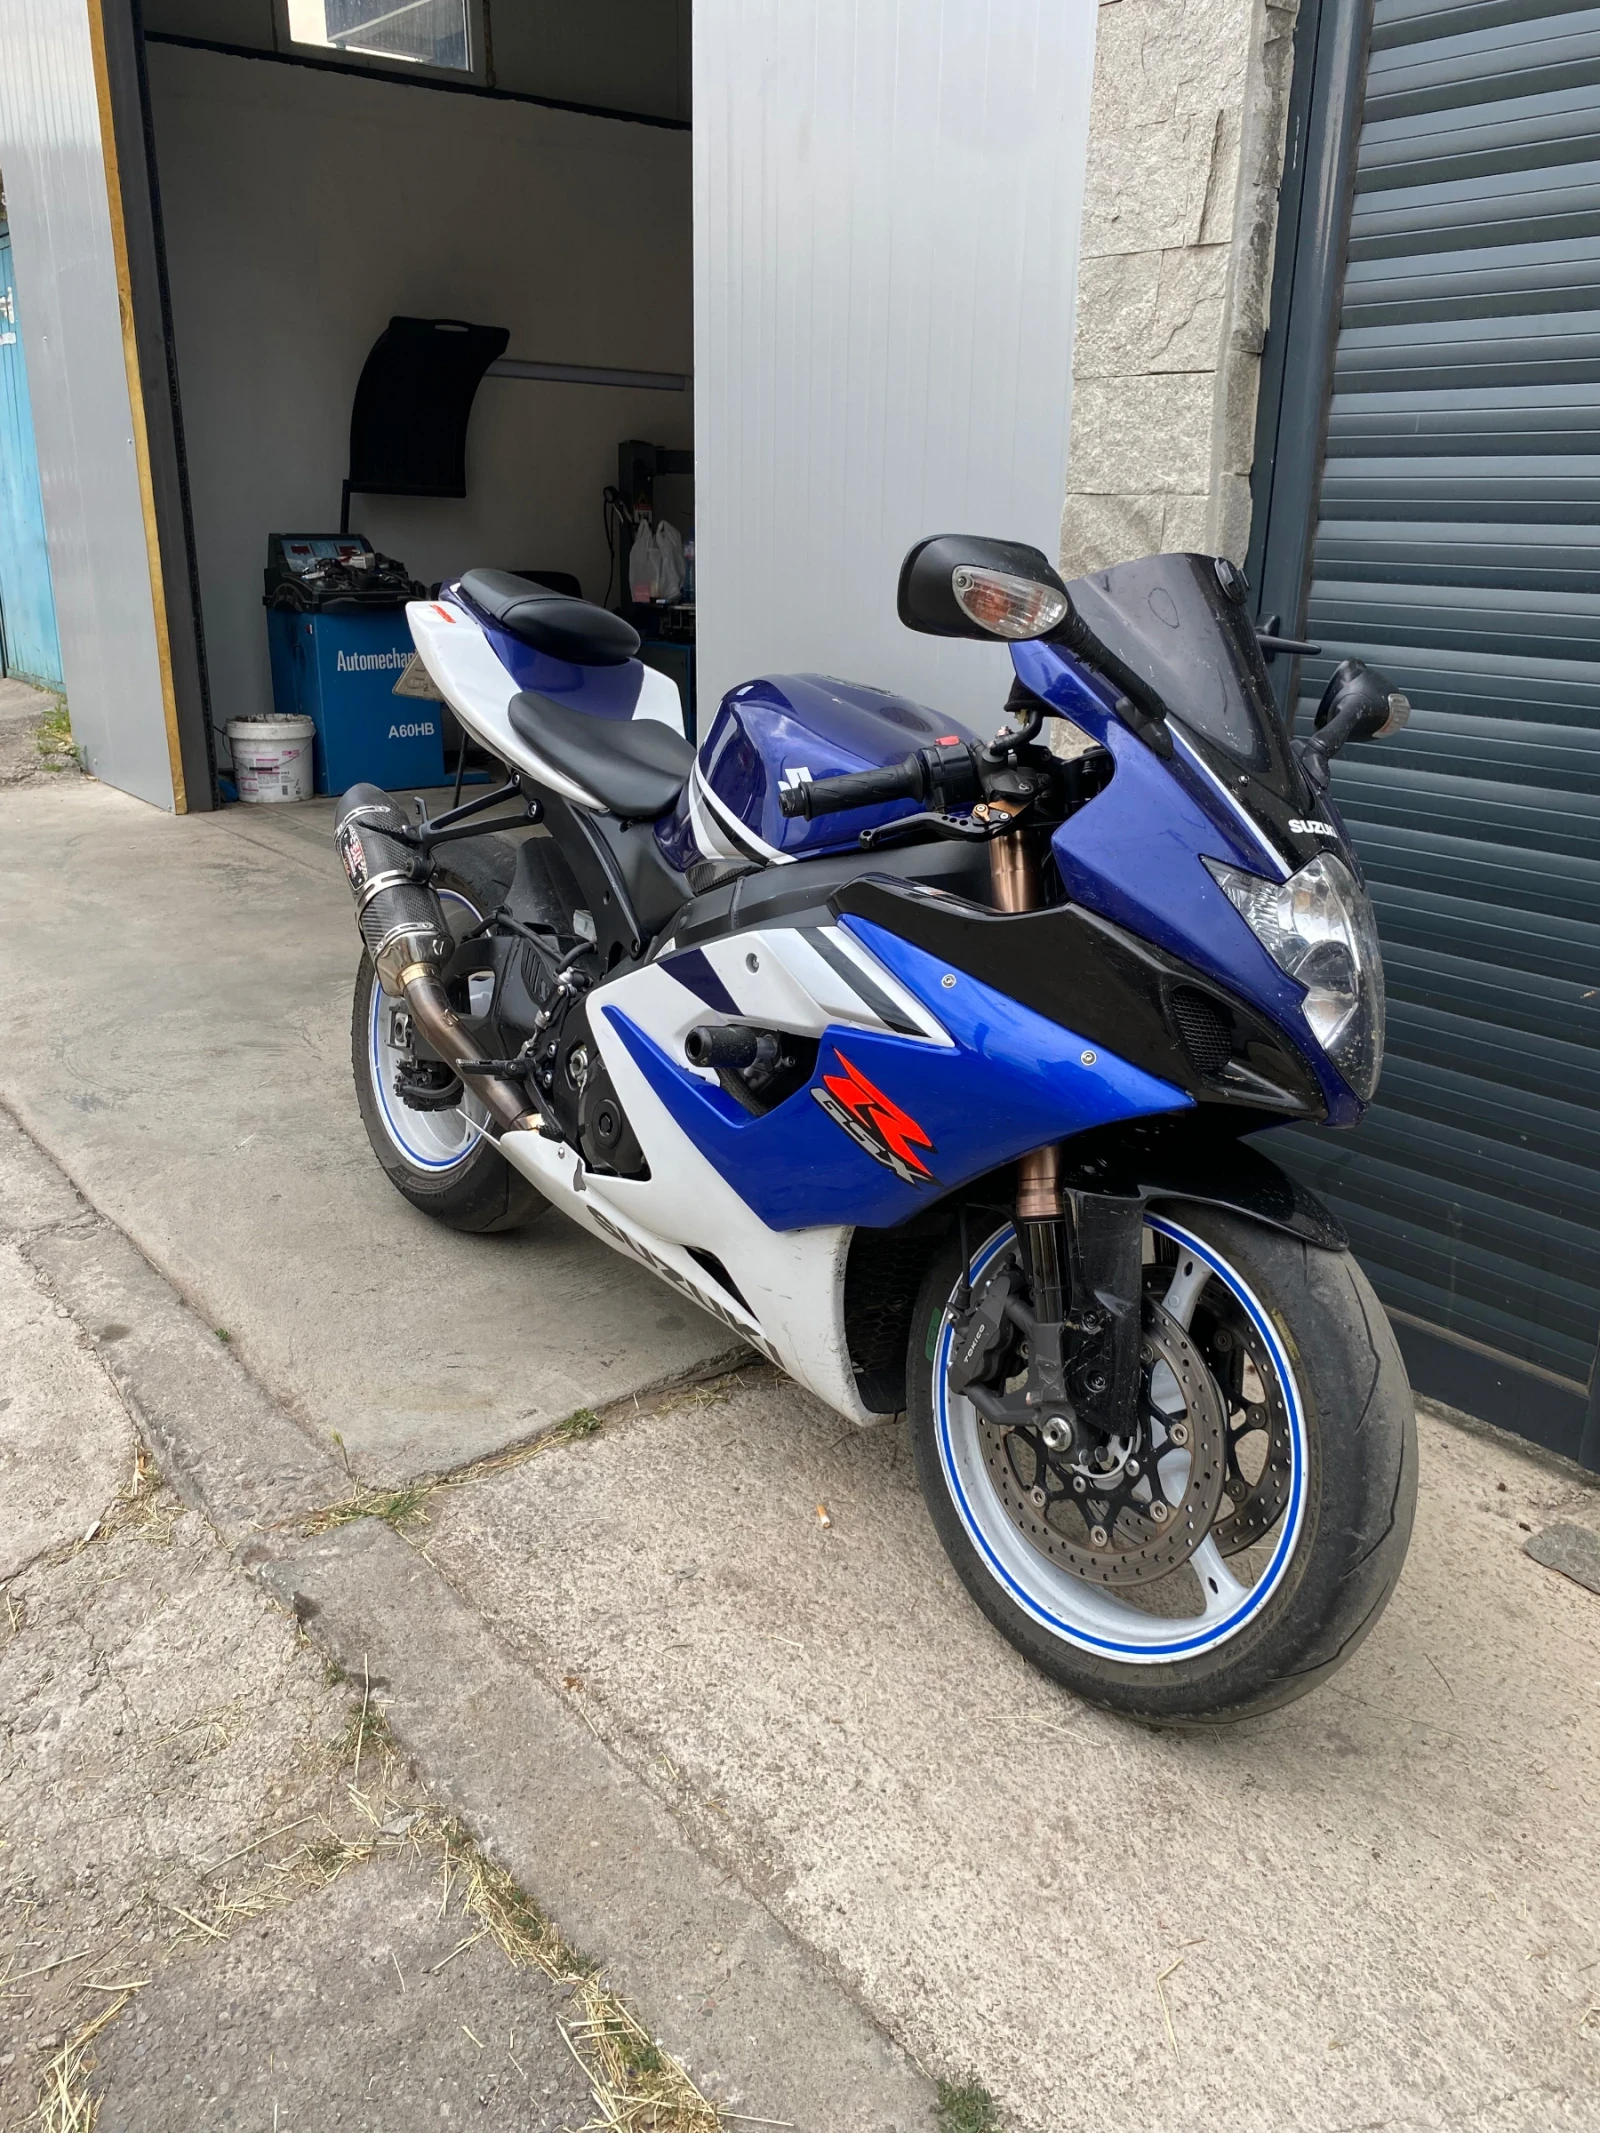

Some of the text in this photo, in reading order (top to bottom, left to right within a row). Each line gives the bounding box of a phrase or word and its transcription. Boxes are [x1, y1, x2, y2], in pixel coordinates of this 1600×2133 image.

[388, 722, 434, 739] A60HB
[586, 1204, 787, 1370] SUZUKI
[963, 1324, 985, 1363] TOKICO
